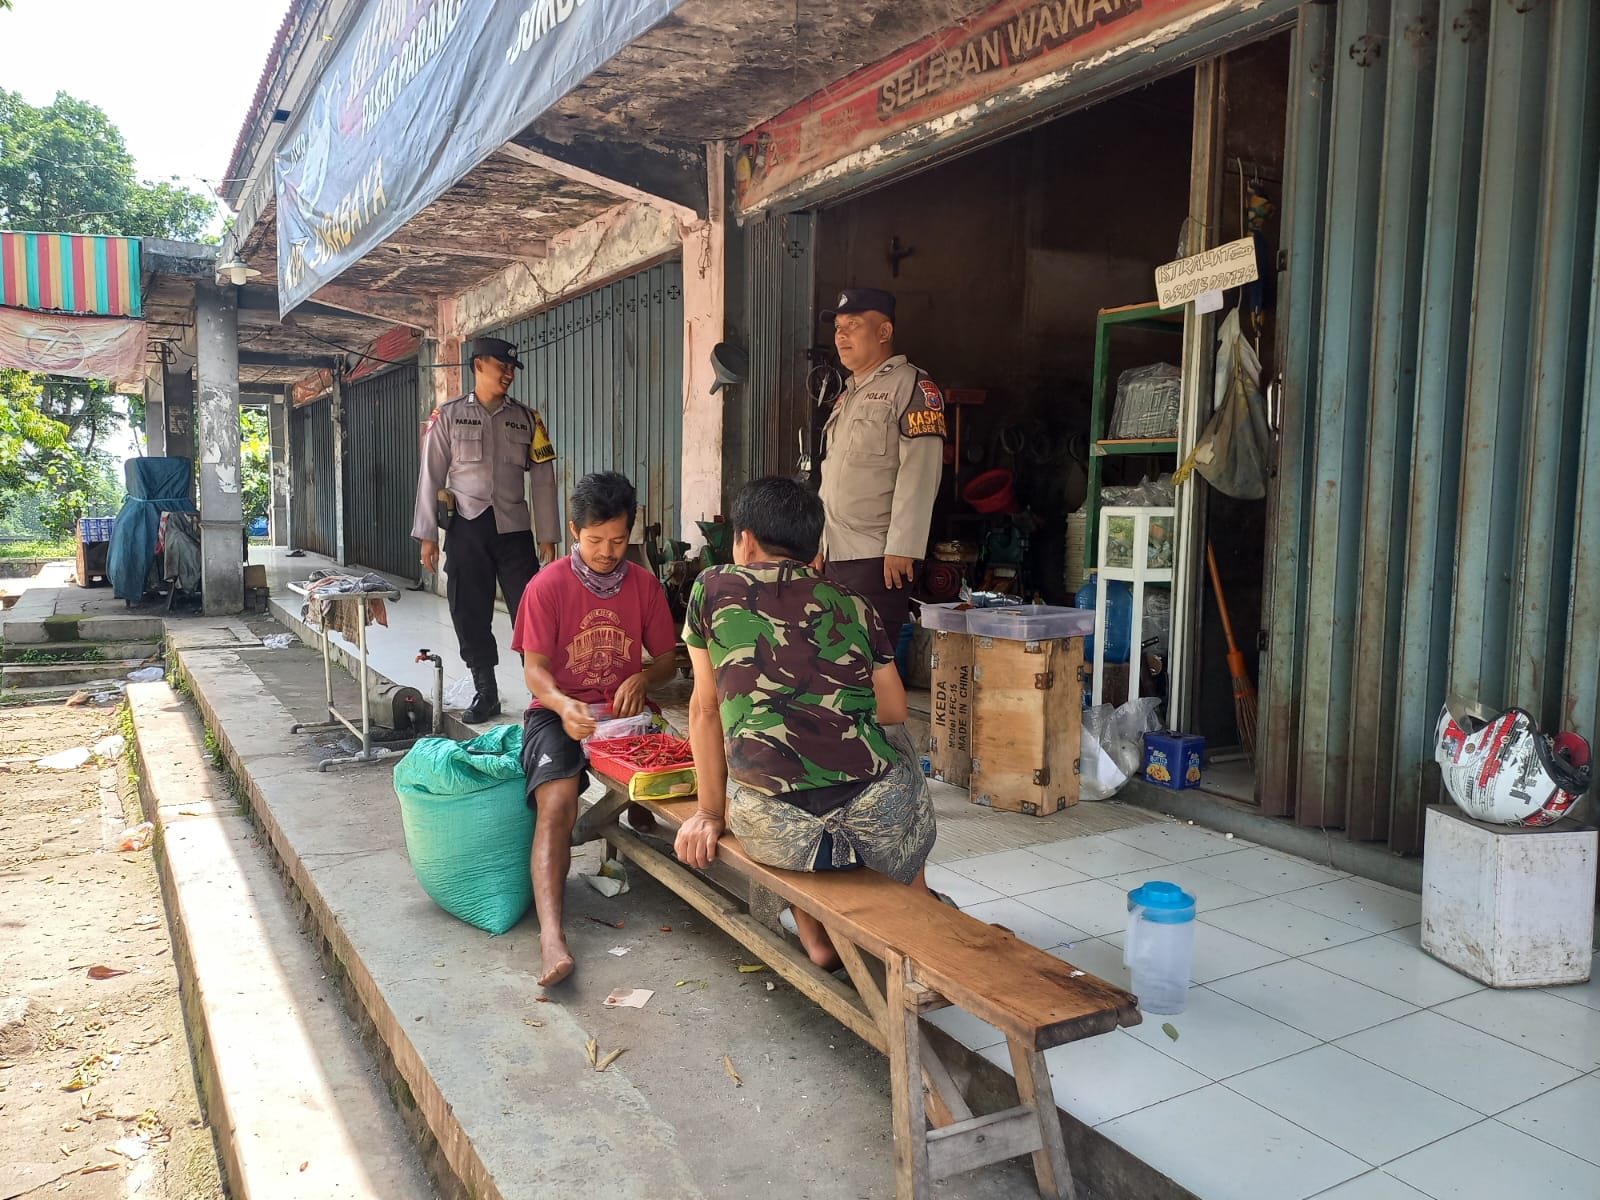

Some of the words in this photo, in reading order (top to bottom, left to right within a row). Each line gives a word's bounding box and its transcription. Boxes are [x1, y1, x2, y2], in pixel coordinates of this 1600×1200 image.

[1007, 0, 1137, 57] WAWA
[361, 55, 399, 140] PASAR
[505, 421, 528, 431] POLRI
[960, 665, 969, 698] CHINA
[936, 681, 947, 727] IKEDA
[949, 683, 958, 716] FFC-15
[958, 703, 968, 715] IN
[958, 720, 968, 752] MADE
